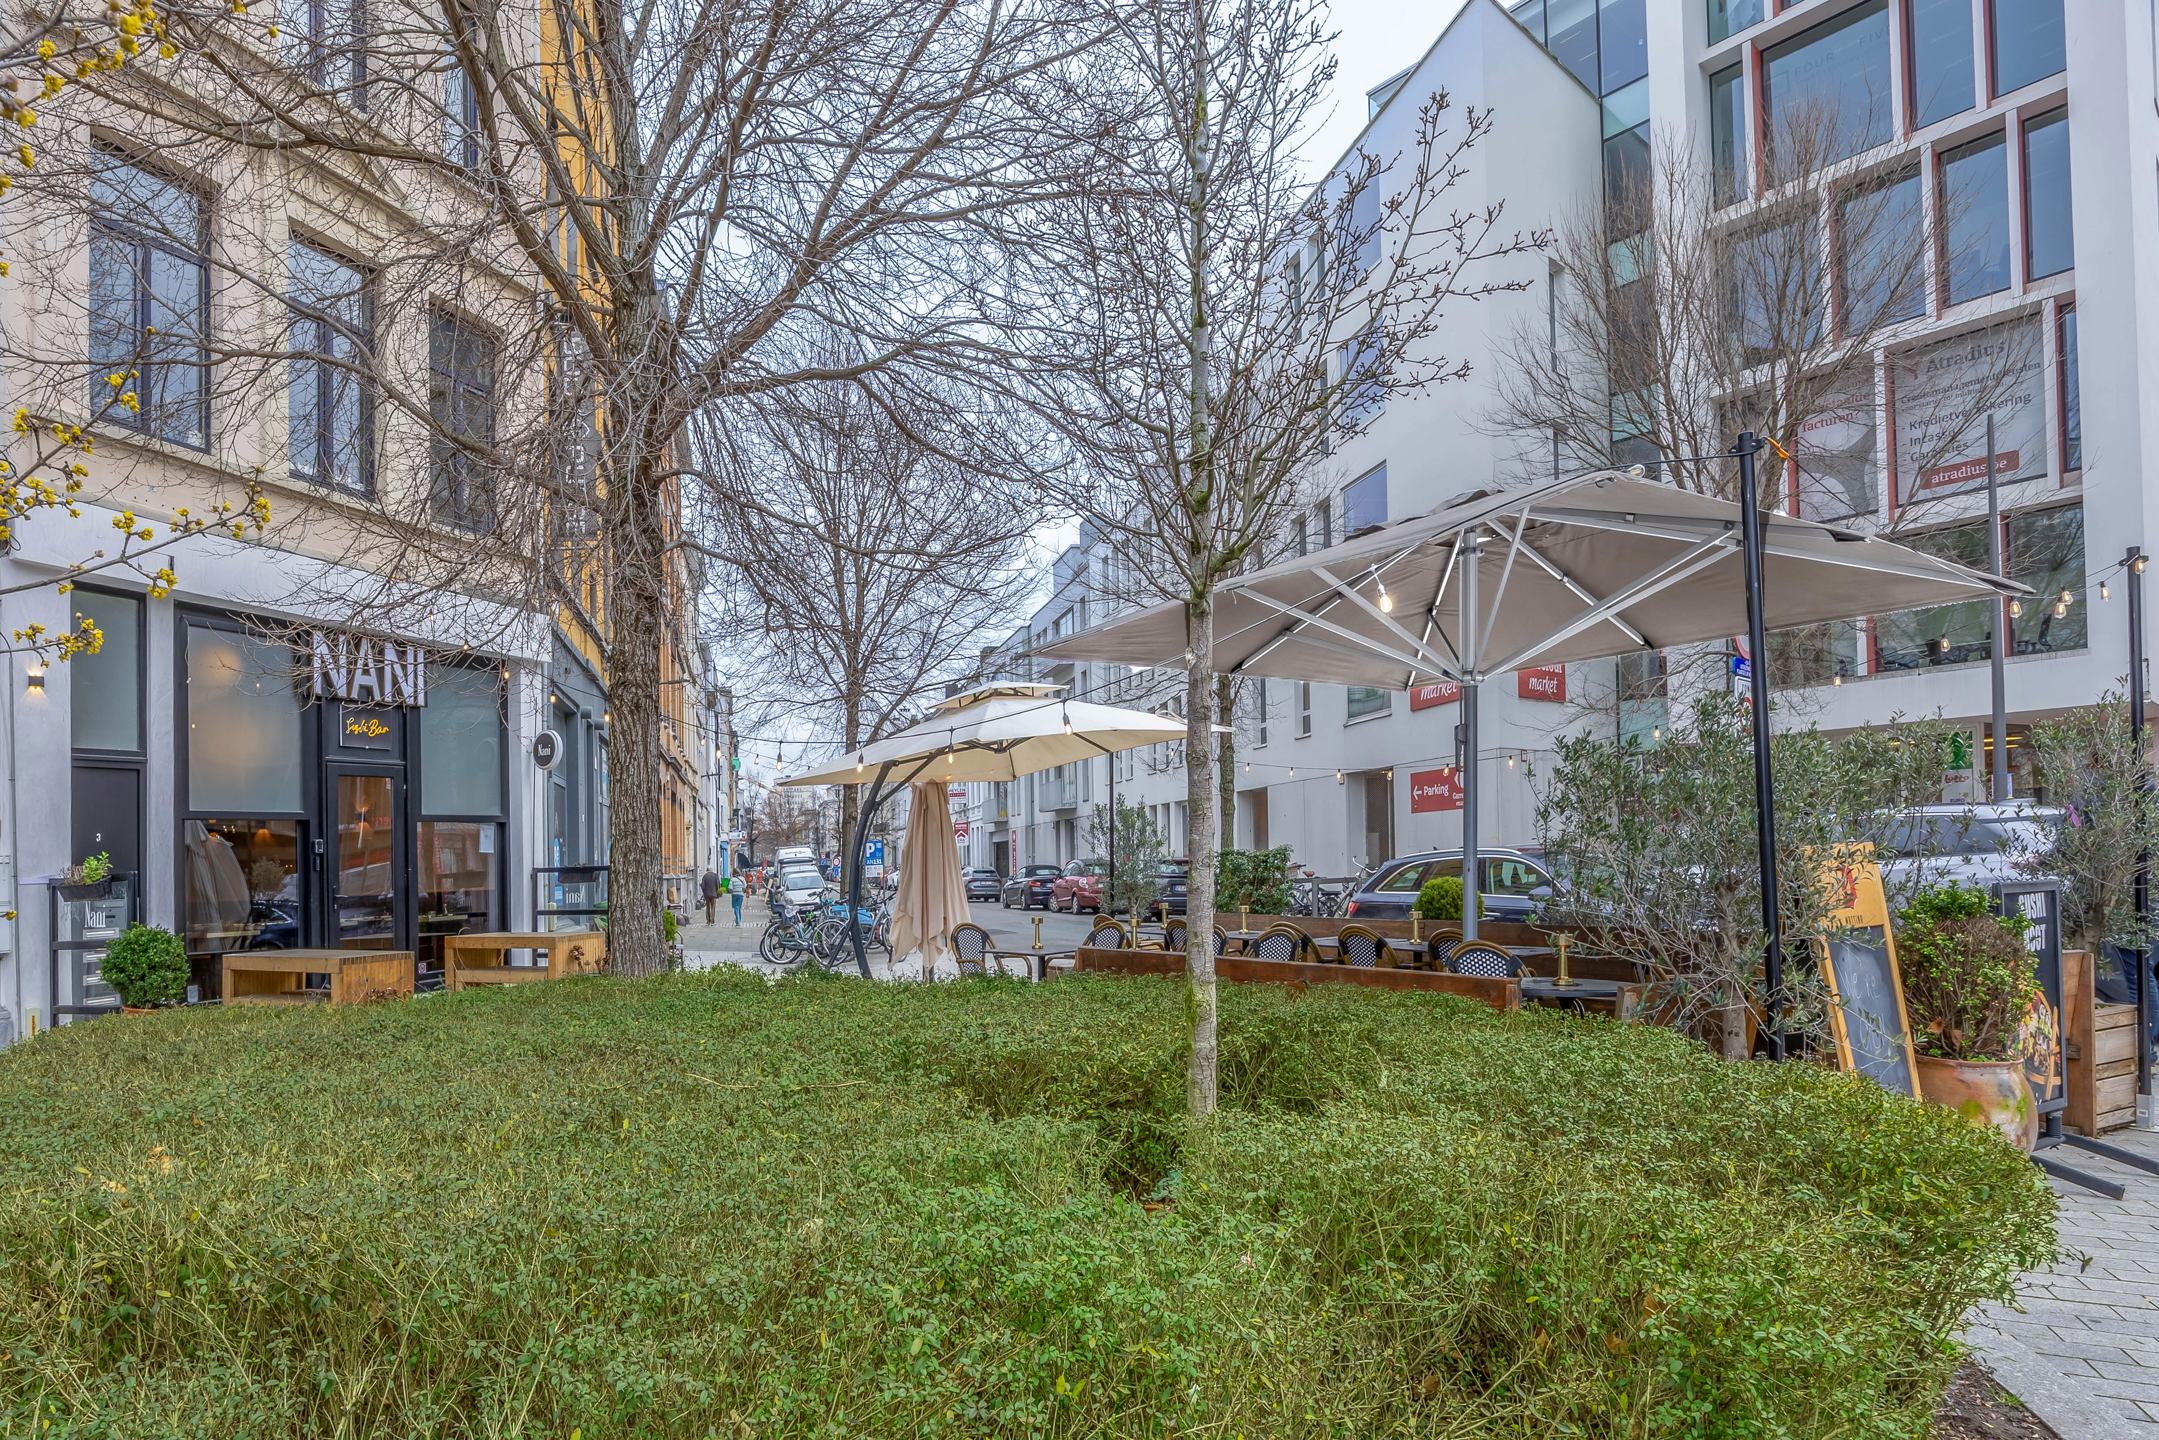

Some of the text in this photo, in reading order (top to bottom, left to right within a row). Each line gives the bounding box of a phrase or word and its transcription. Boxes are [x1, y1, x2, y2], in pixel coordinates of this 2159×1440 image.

[1926, 340, 2005, 373] Atradius
[1802, 410, 1860, 433] facturen?
[1931, 458, 2007, 484] atradiusbe
[313, 631, 425, 707] NANI
[1420, 681, 1457, 701] market
[1529, 675, 1558, 694] market
[368, 719, 389, 737] Bar
[537, 743, 552, 757] Nani
[1423, 784, 1449, 796] Parking
[96, 832, 101, 842] 3
[866, 842, 875, 858] P
[84, 898, 106, 928] Nani
